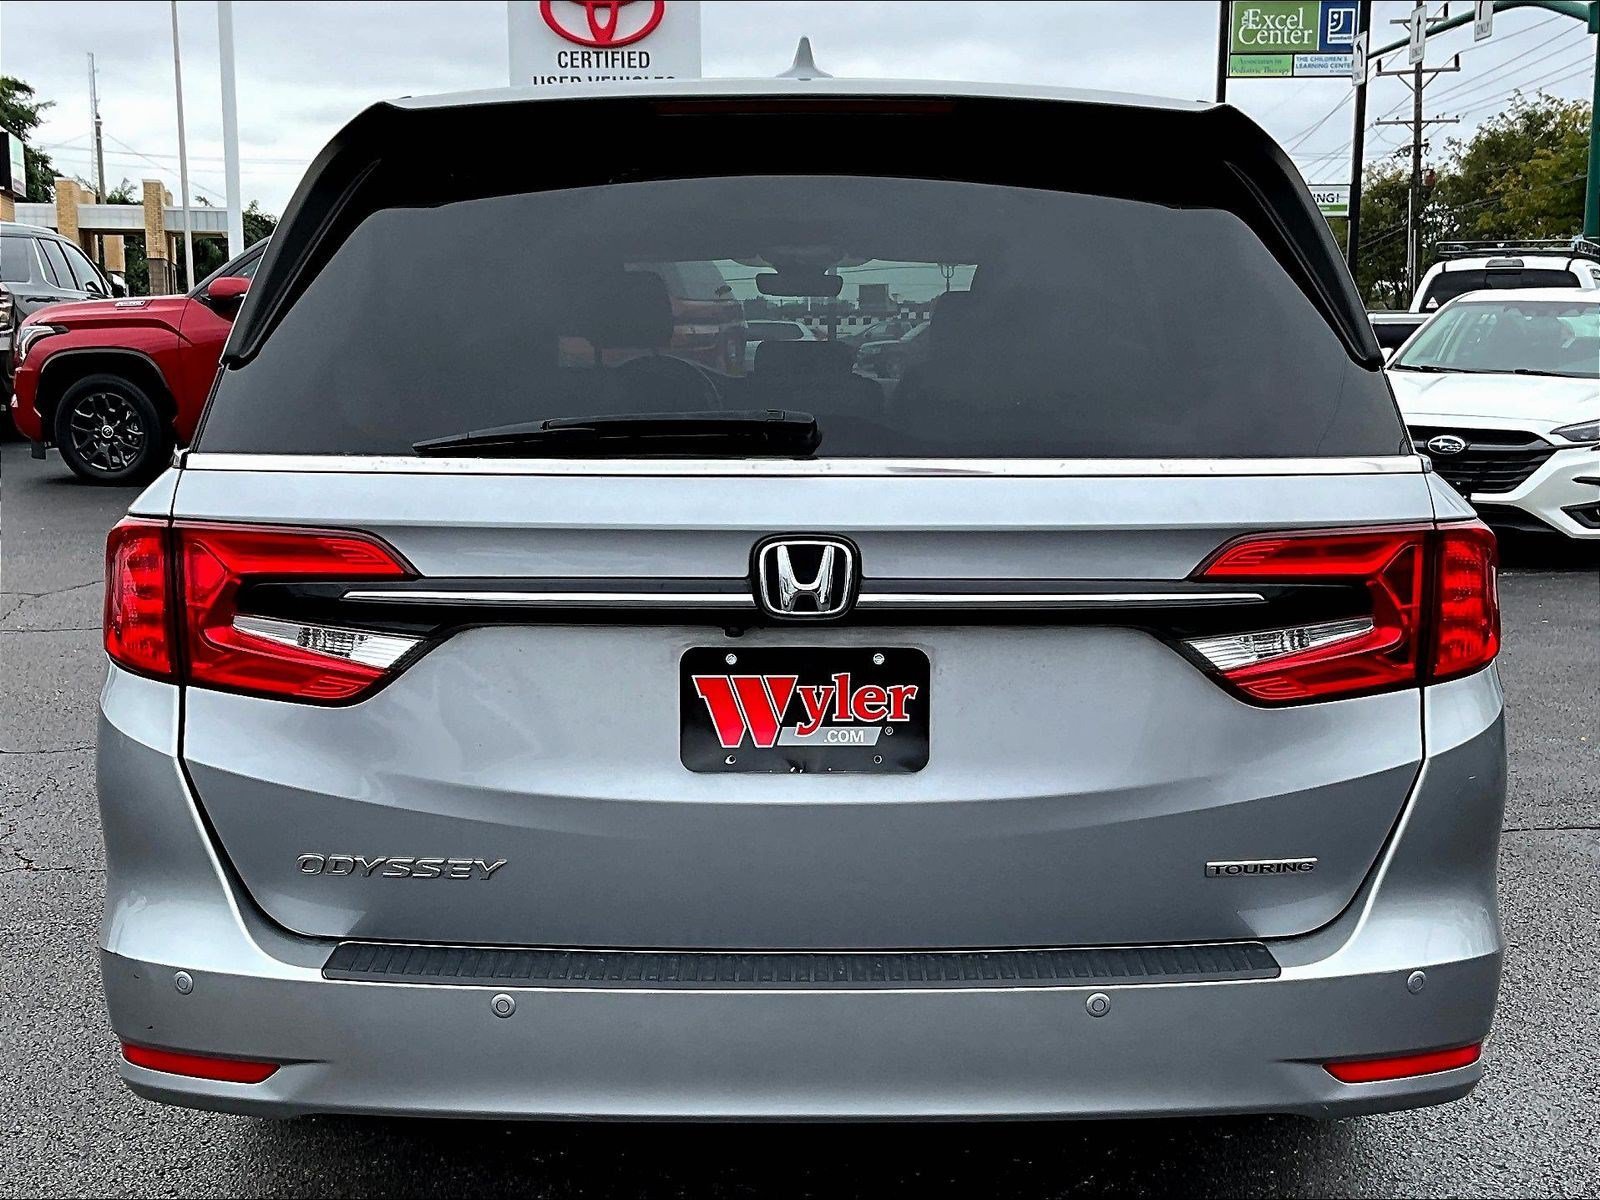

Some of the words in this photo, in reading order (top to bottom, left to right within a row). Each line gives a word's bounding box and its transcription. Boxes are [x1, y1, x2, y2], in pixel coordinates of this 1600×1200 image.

[1246, 8, 1304, 30] Excel
[1238, 25, 1313, 45] Center
[557, 50, 650, 69] CERTIFIED
[692, 672, 918, 748] Wyler
[823, 729, 864, 743] .COM
[297, 853, 508, 880] ODYSSEY
[1210, 861, 1315, 875] TOURING
